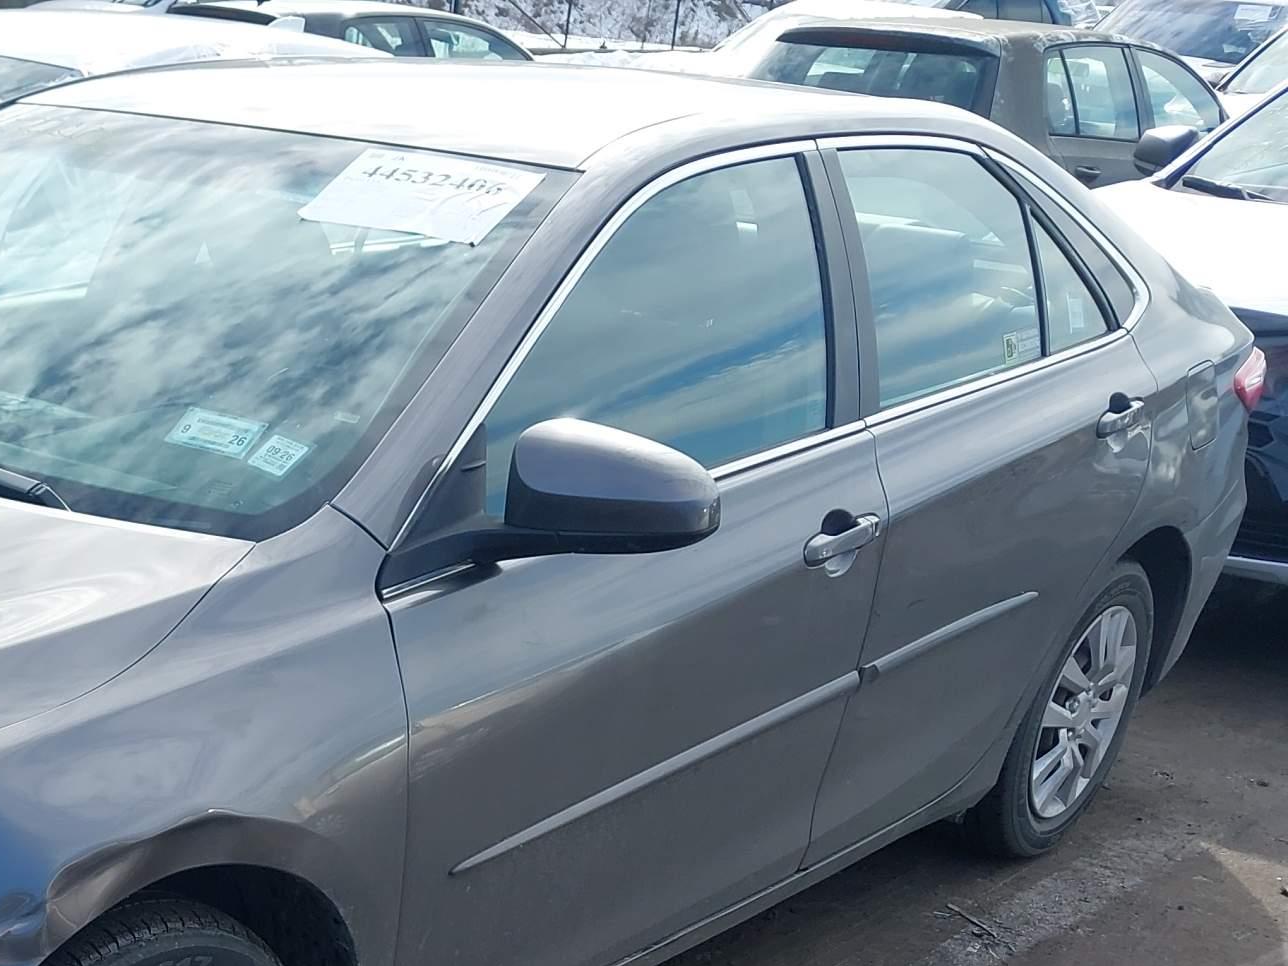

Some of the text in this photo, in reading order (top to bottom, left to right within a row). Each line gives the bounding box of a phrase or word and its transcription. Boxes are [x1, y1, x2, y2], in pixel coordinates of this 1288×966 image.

[362, 164, 507, 196] 44532406
[180, 423, 192, 434] 9
[228, 434, 248, 447] 26
